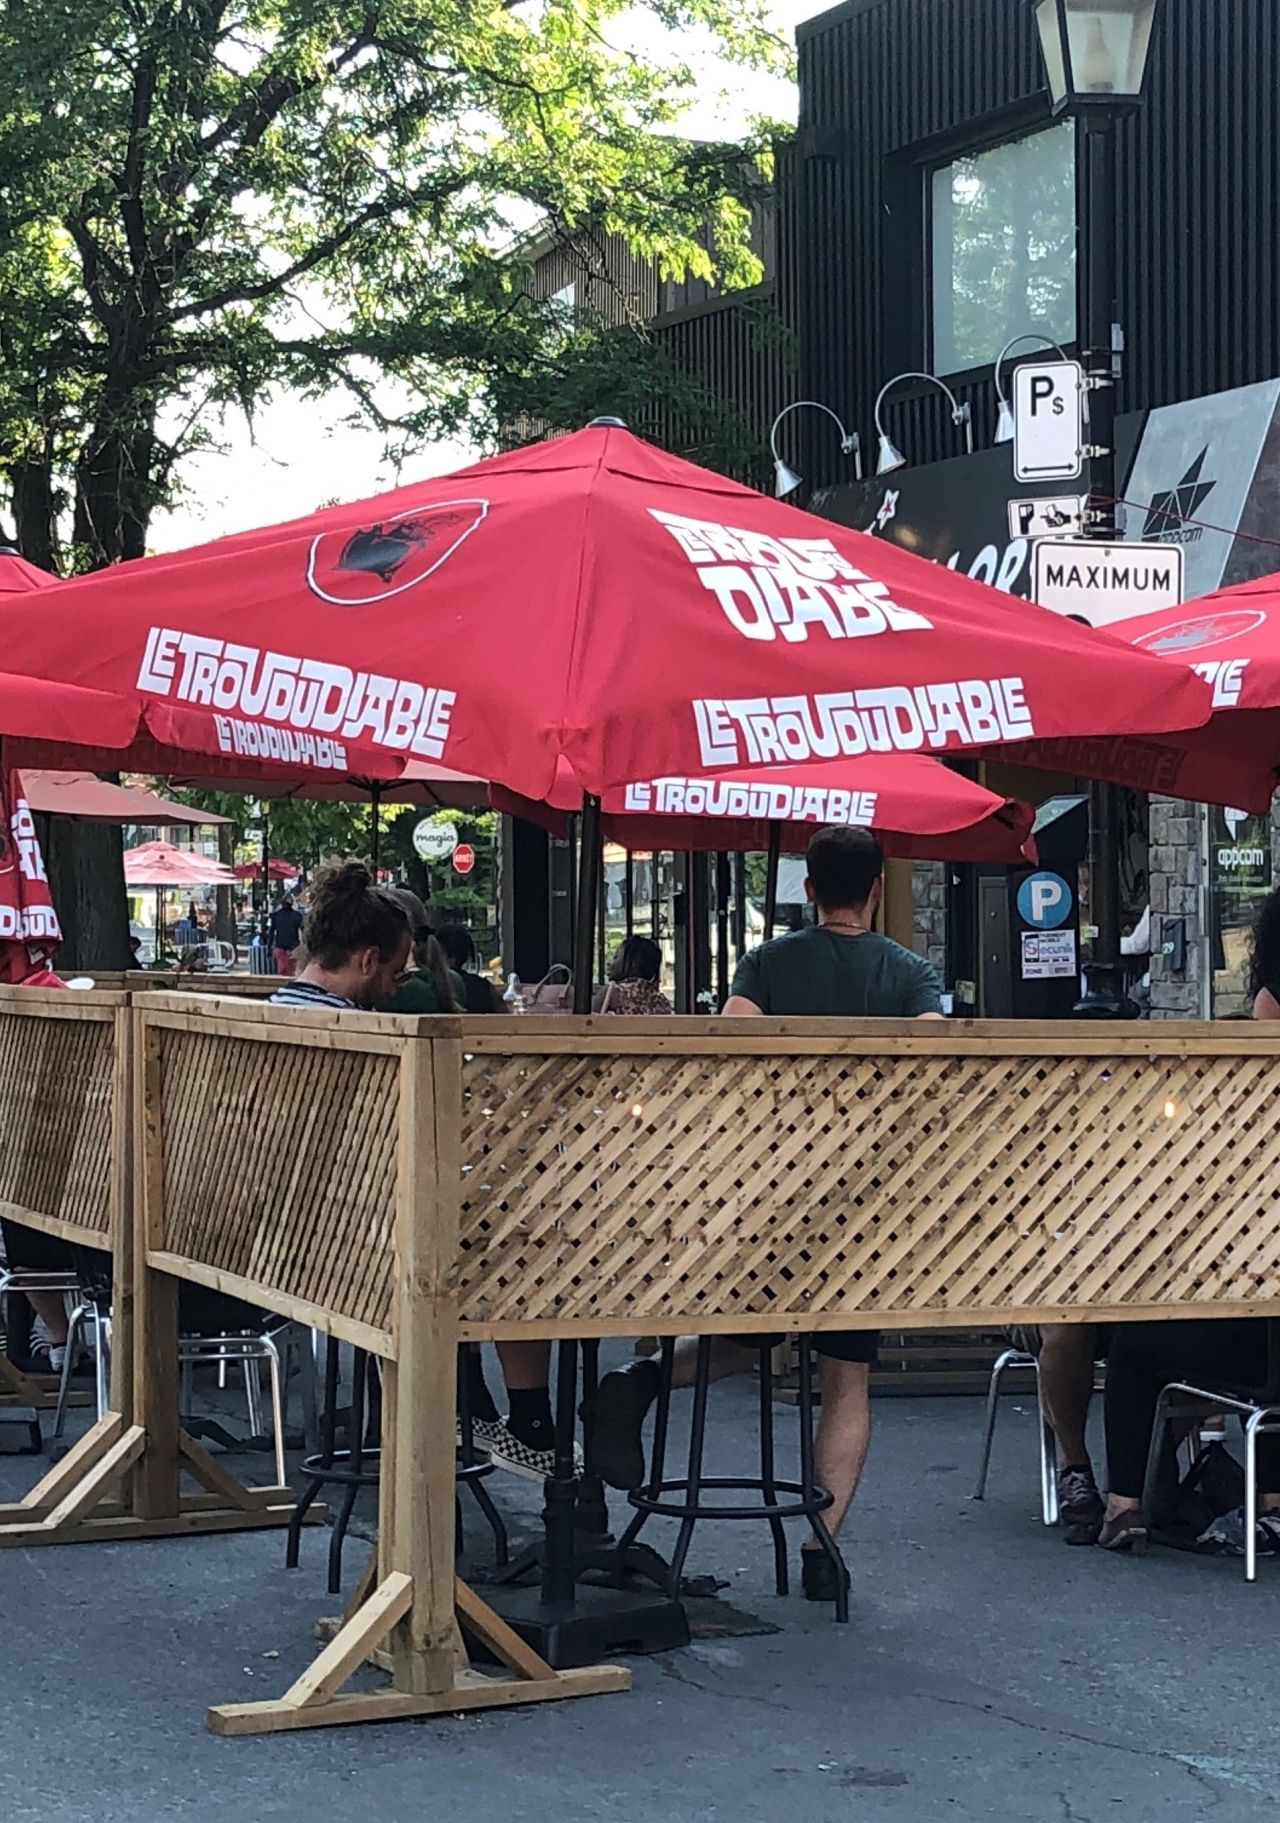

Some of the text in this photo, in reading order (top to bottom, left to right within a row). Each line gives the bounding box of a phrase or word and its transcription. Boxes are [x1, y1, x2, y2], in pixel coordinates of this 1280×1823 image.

[1046, 564, 1170, 591] MAXIMUM
[1217, 848, 1264, 871] appcom
[1031, 880, 1062, 921] P
